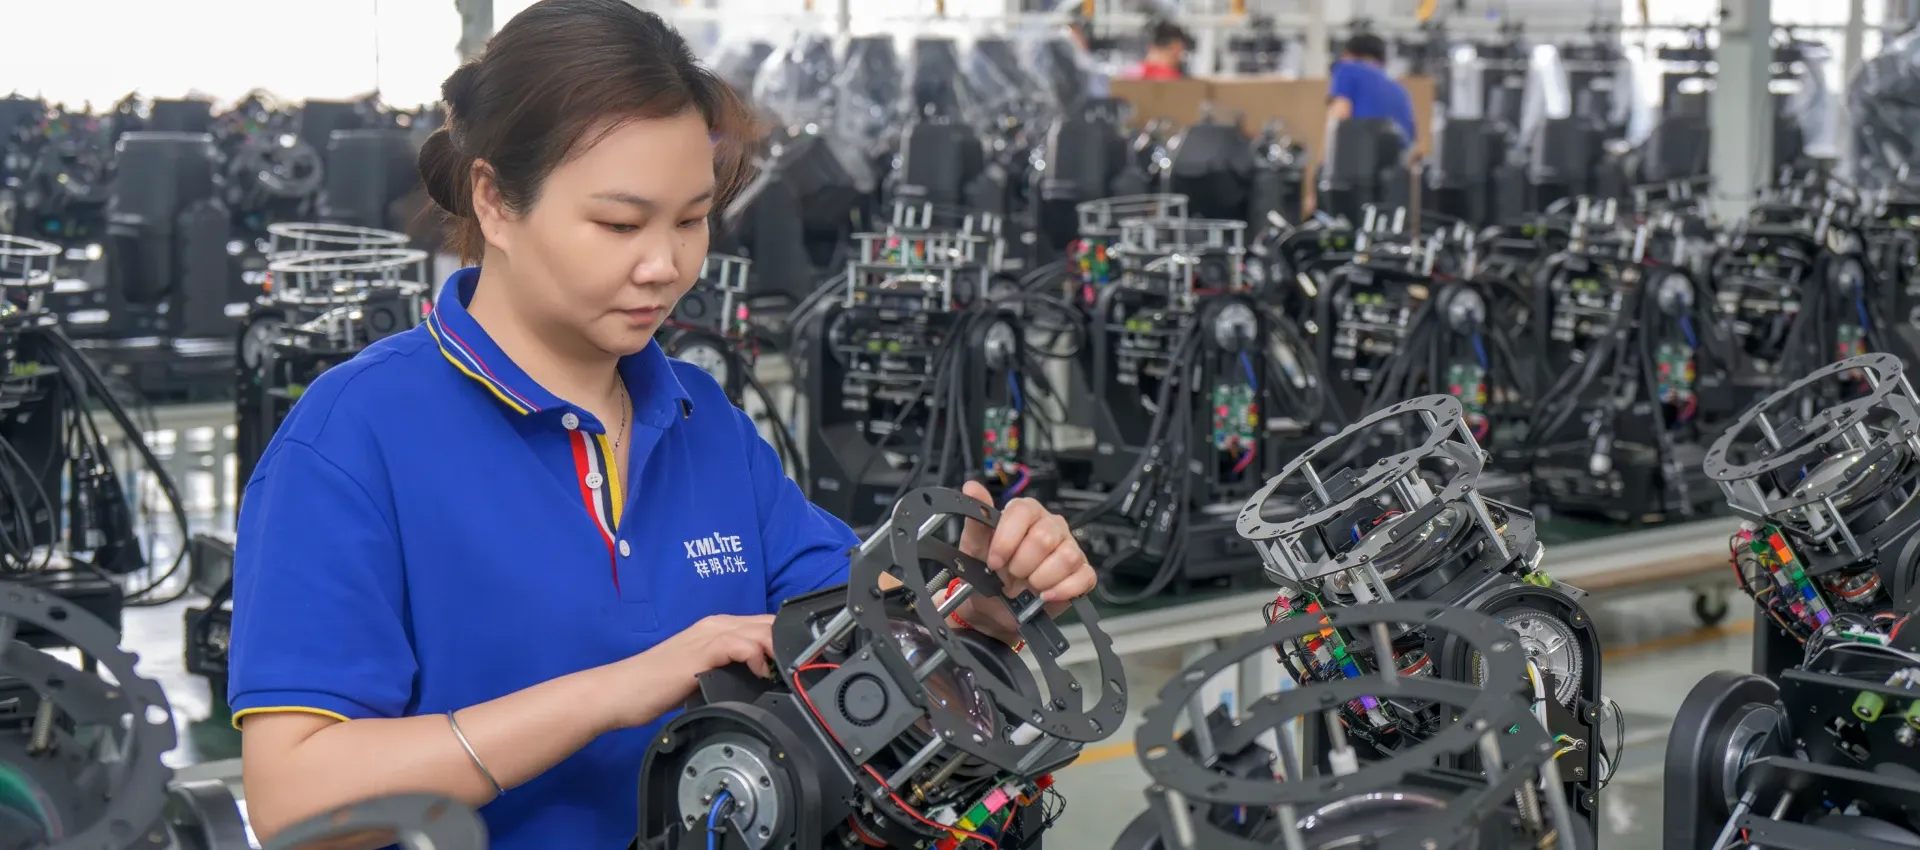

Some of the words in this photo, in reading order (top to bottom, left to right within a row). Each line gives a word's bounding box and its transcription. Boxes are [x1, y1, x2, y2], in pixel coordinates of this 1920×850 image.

[683, 531, 743, 559] XMLITE
[693, 554, 748, 579] 祥明灯光
